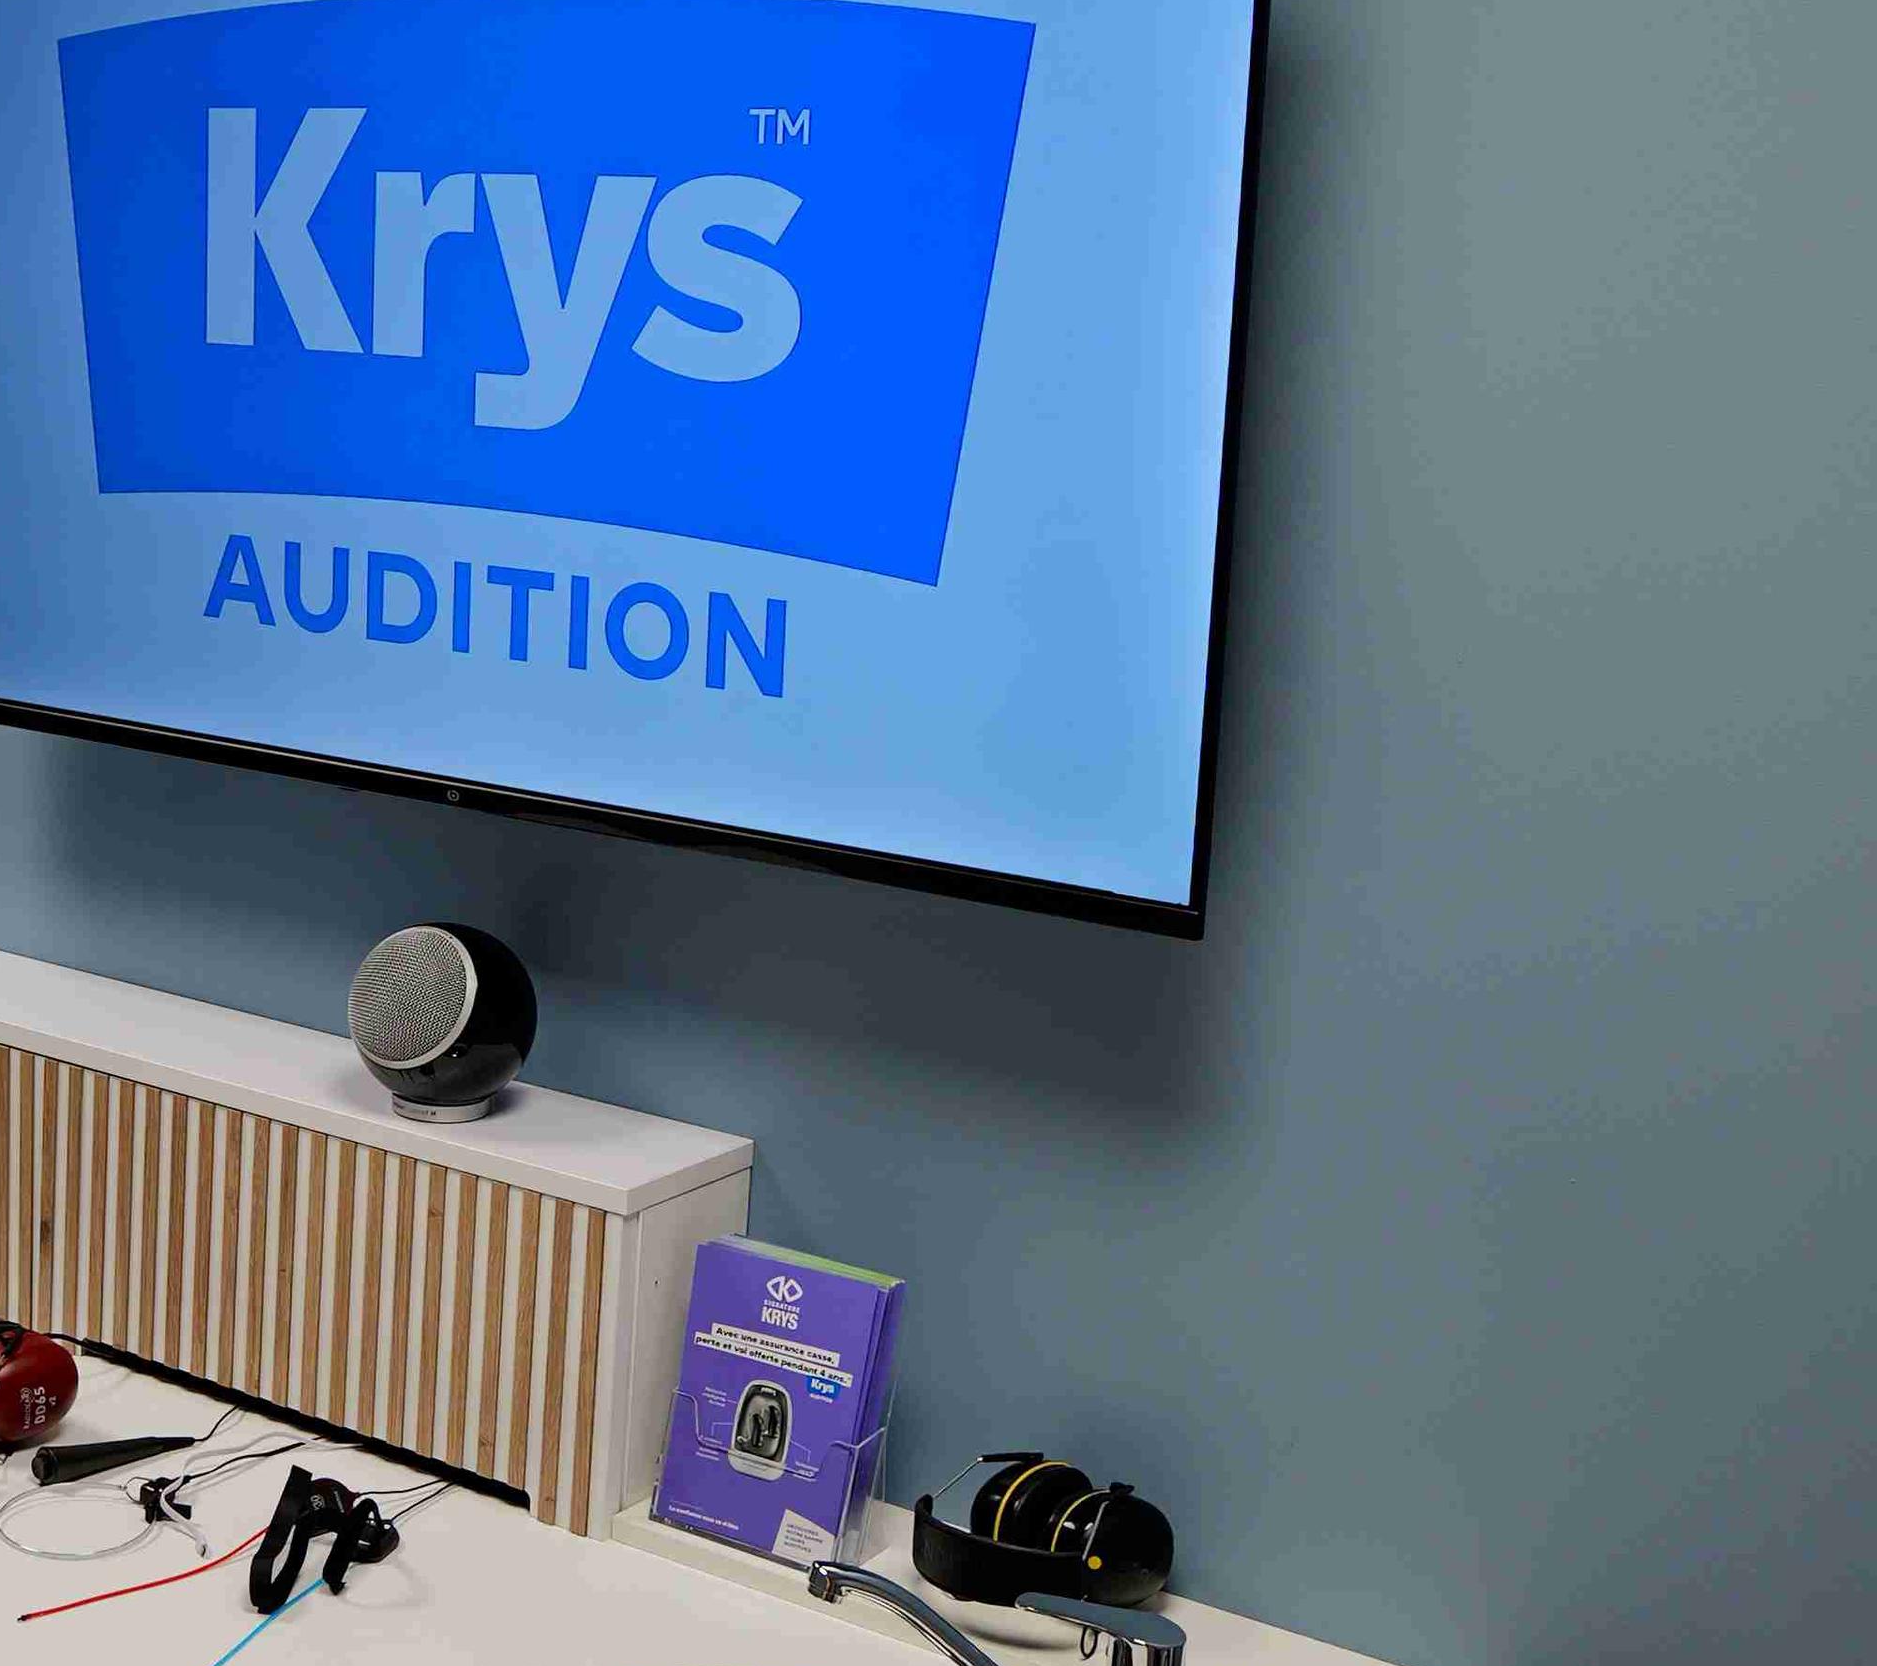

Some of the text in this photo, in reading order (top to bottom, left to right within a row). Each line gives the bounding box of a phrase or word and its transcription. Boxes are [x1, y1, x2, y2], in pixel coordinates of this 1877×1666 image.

[750, 107, 812, 146] TM
[204, 106, 806, 431] Krys
[202, 532, 789, 699] AUDITION
[761, 1306, 800, 1330] KRYS
[716, 1327, 738, 1338] Avec
[741, 1332, 757, 1343] une
[759, 1338, 805, 1355] assurance
[780, 1357, 817, 1375] pendant
[34, 1386, 46, 1425] DD65
